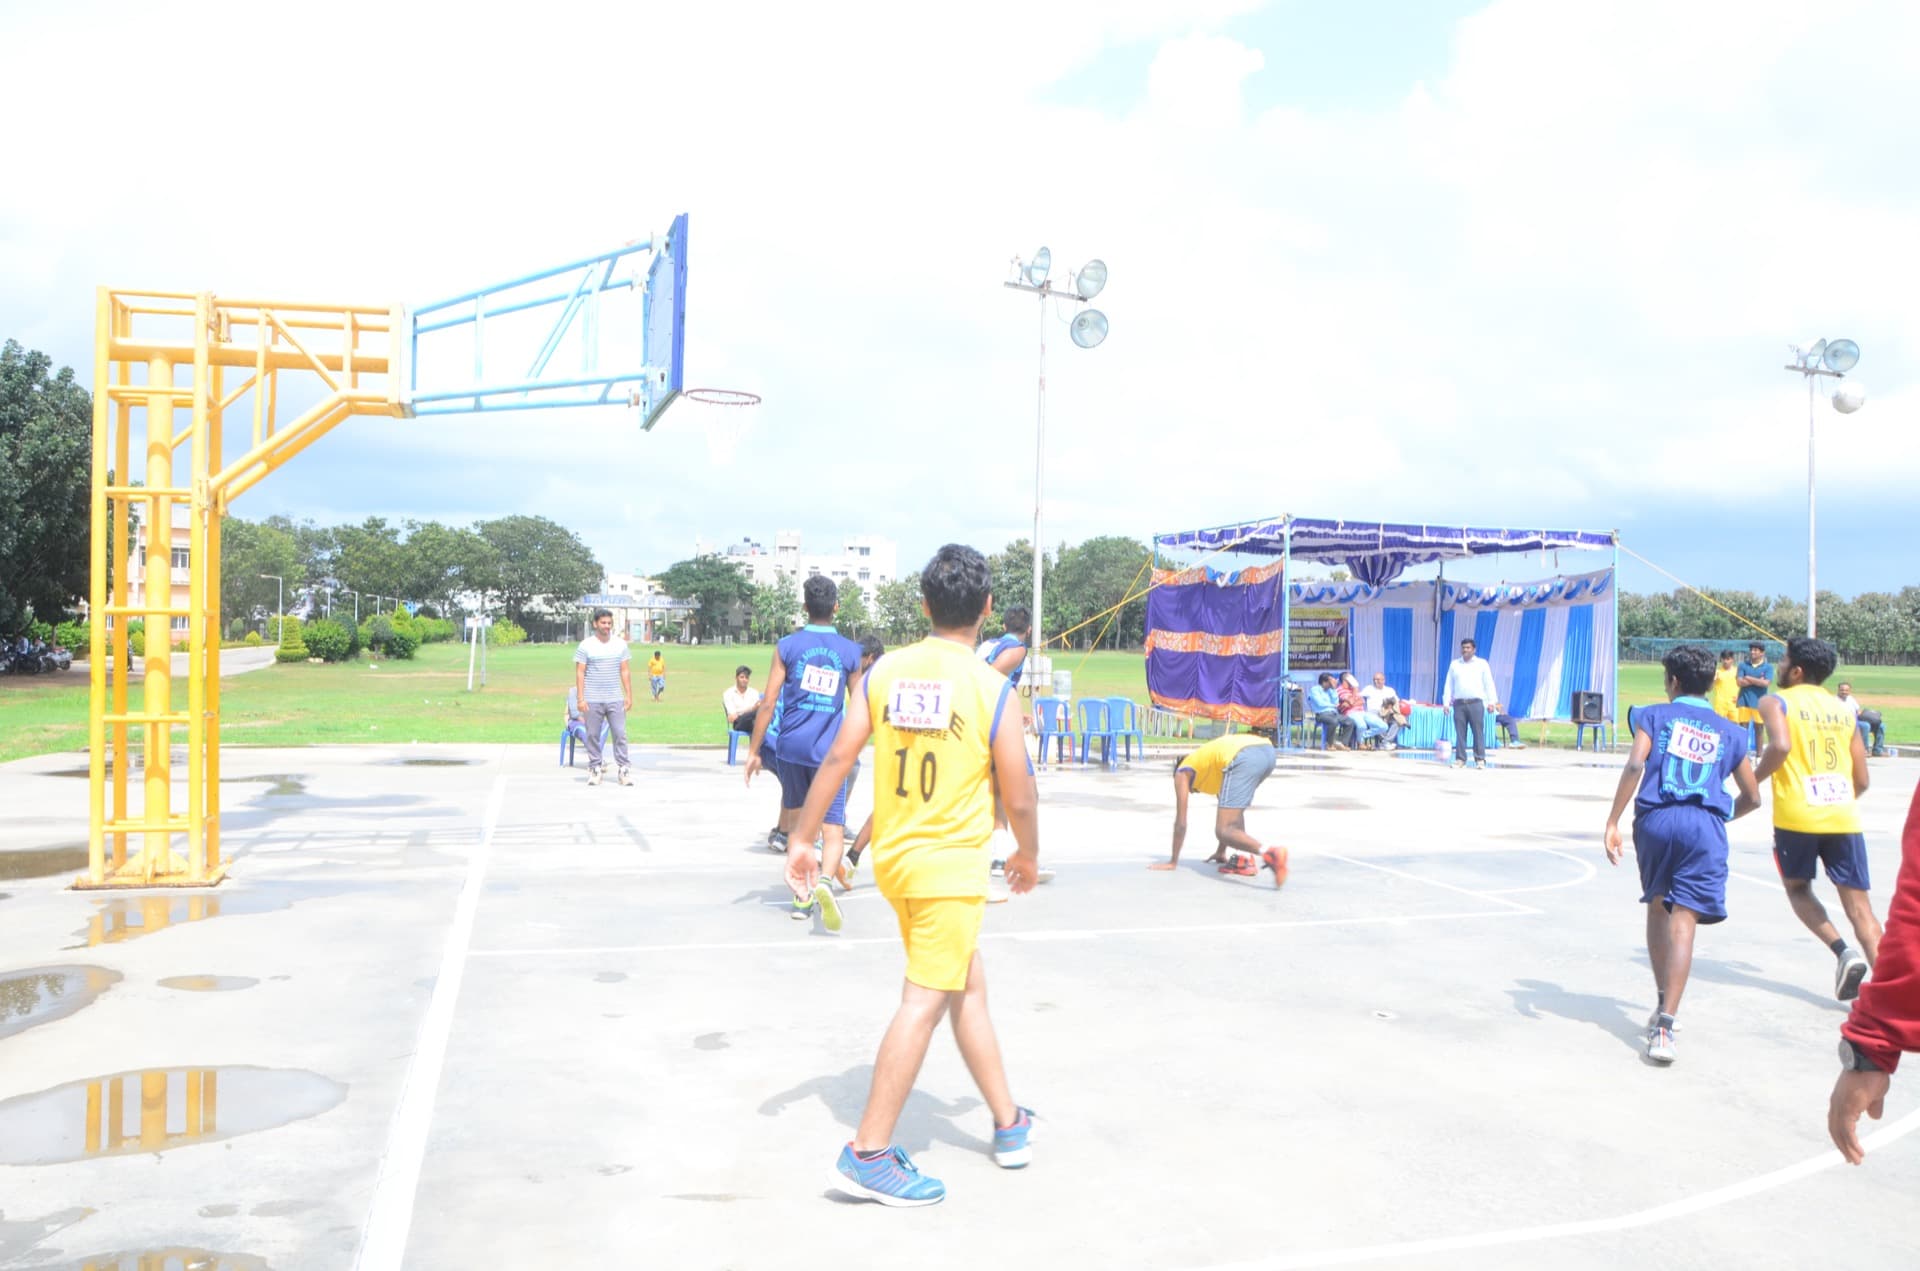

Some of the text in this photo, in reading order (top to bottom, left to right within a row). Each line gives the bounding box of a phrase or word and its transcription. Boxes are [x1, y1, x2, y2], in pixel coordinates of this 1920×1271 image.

[807, 673, 833, 688] 111
[893, 692, 941, 715] 131
[898, 715, 932, 725] MBA
[1677, 733, 1716, 756] 109
[1808, 737, 1838, 771] 15
[1678, 750, 1704, 763] MBA
[895, 746, 937, 804] 10
